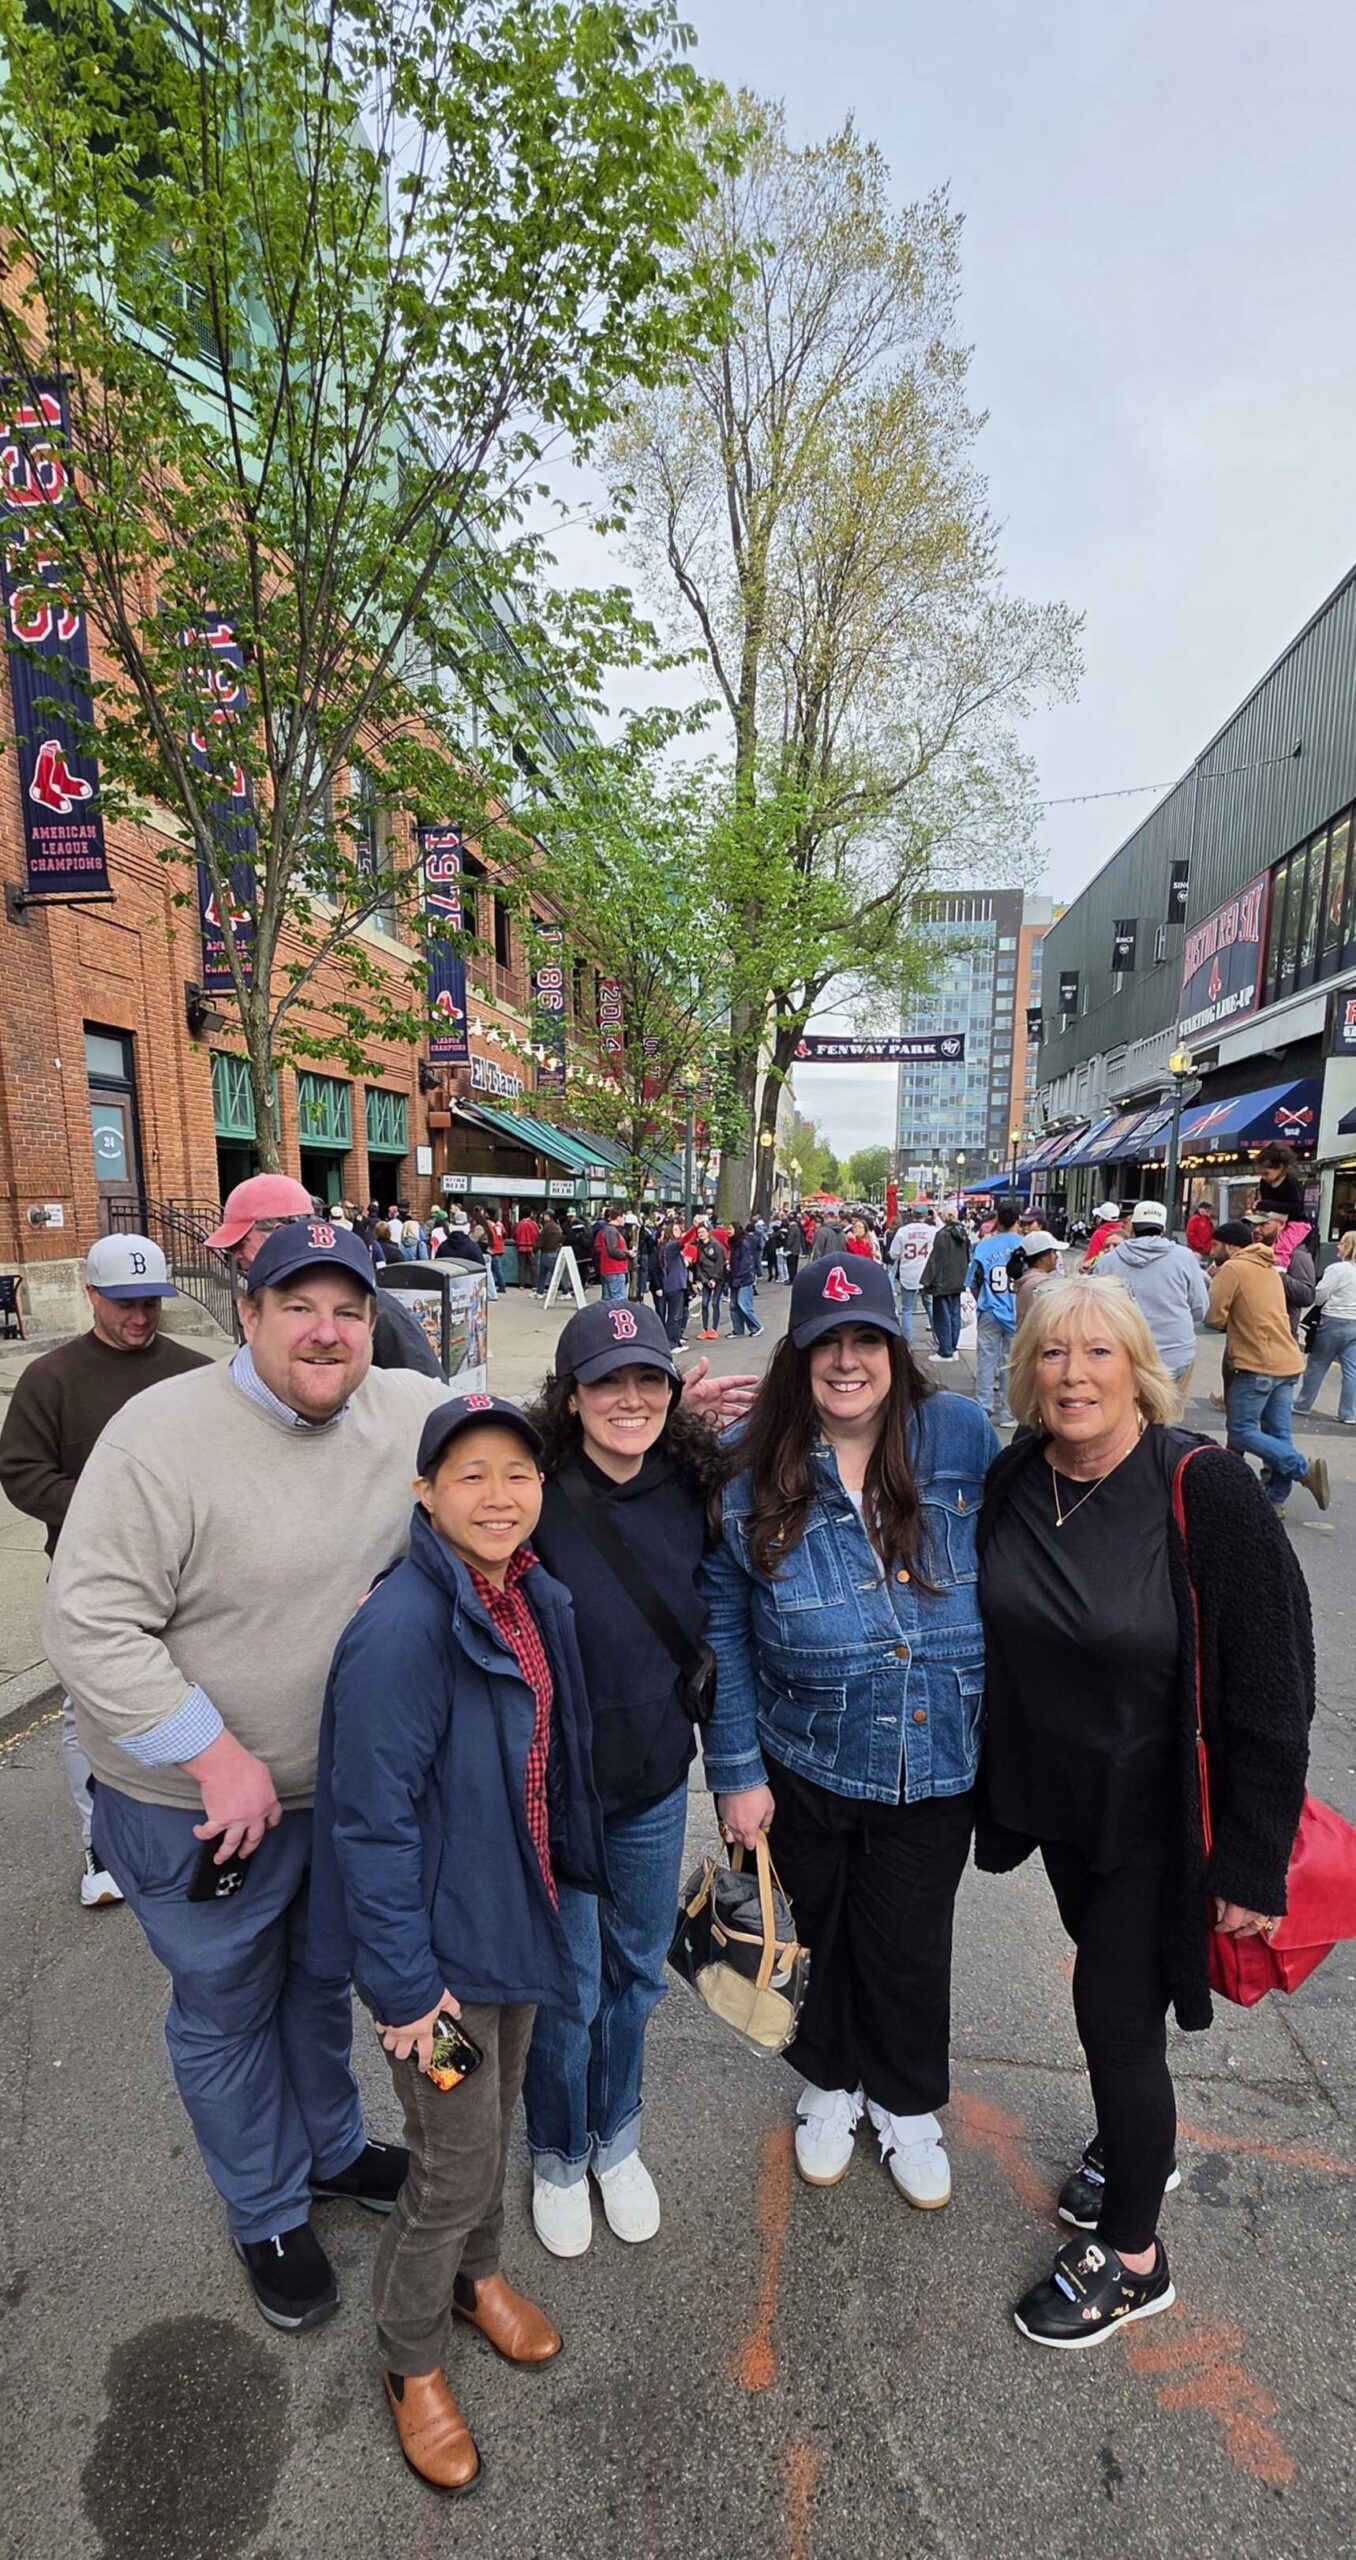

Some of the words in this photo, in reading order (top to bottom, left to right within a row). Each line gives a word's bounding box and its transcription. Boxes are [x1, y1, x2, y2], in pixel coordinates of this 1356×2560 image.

[32, 825, 97, 839] AMERICAN
[42, 841, 89, 855] LEAGUE
[30, 857, 103, 871] CHAMPIONS
[1115, 936, 1134, 944] SINCE
[1182, 917, 1218, 990] BOSTON
[1217, 902, 1239, 950] RED
[1239, 883, 1263, 943] SOX
[600, 985, 621, 1054] 2004
[1179, 1003, 1216, 1038] STARTING
[816, 1044, 886, 1055] FENWAY
[888, 1044, 937, 1055] PARK
[470, 1053, 487, 1091] El
[307, 1223, 336, 1249] B
[904, 1242, 929, 1260] 34
[129, 1252, 147, 1275] B
[608, 1308, 638, 1340] B
[462, 1393, 494, 1412] B
